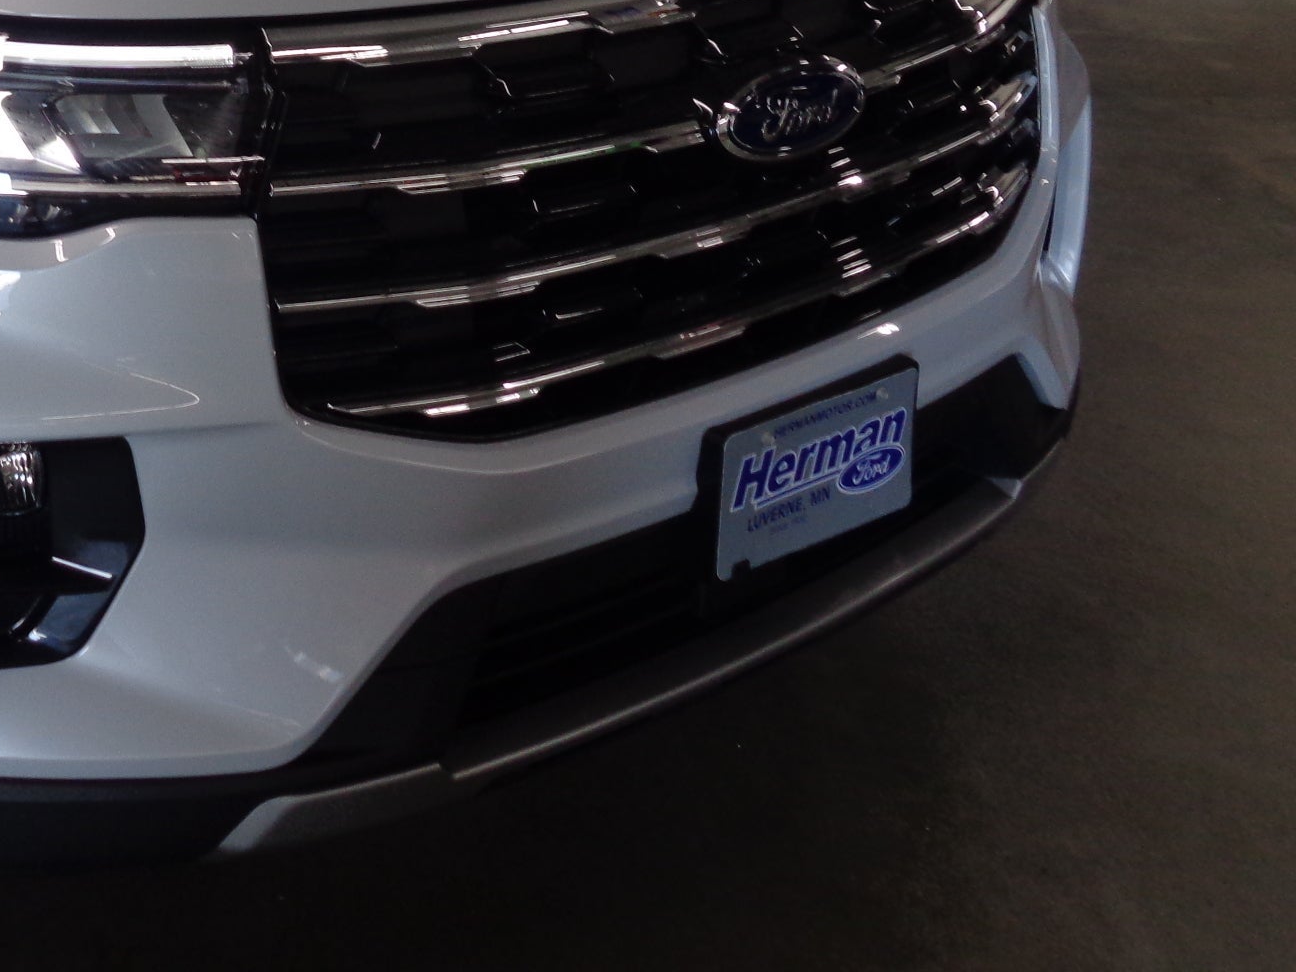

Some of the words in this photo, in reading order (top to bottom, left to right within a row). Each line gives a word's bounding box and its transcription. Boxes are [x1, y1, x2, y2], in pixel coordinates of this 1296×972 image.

[761, 86, 839, 143] Ford
[731, 408, 906, 511] Herman
[852, 453, 892, 486] Ford
[810, 486, 831, 506] MN
